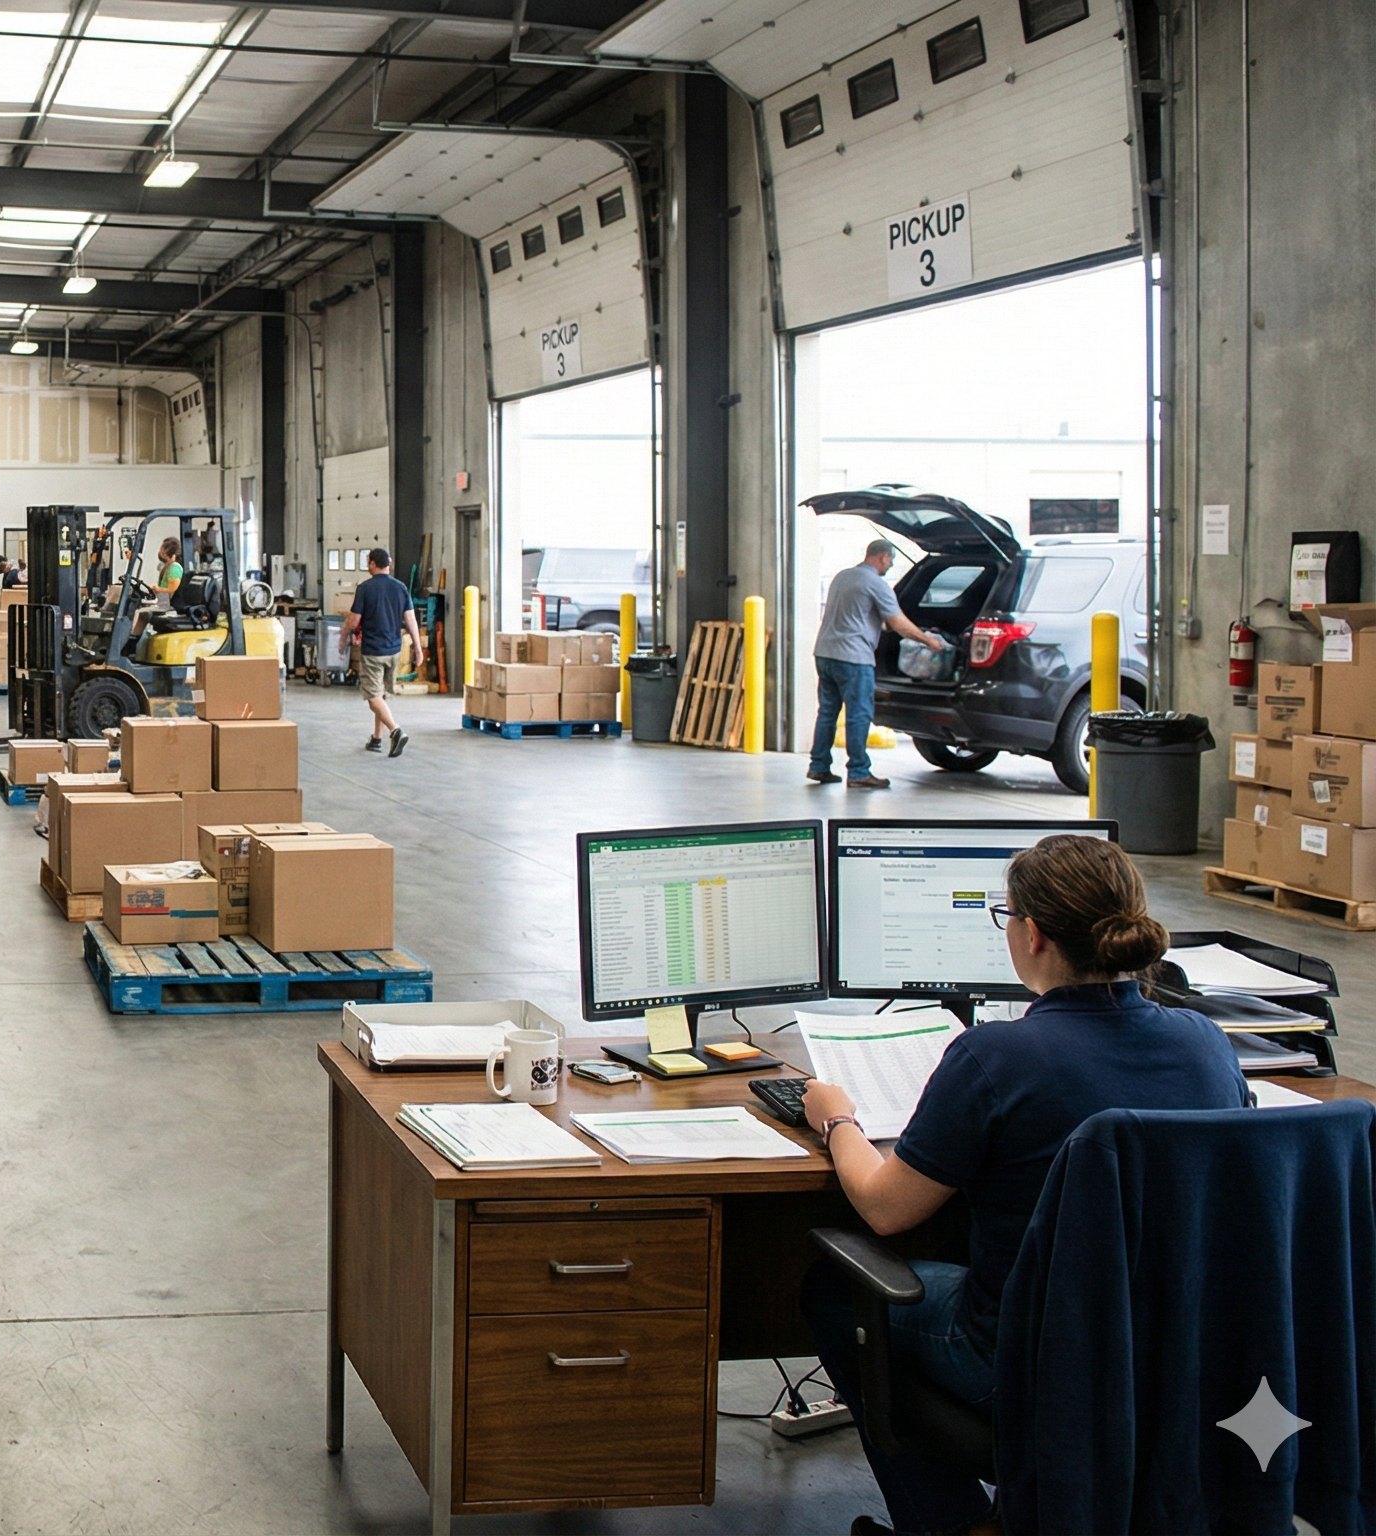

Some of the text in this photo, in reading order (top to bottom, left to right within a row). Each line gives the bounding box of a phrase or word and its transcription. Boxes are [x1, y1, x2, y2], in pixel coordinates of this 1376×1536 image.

[889, 203, 965, 250] PICKUP
[920, 249, 936, 287] 3
[557, 352, 566, 377] 3
